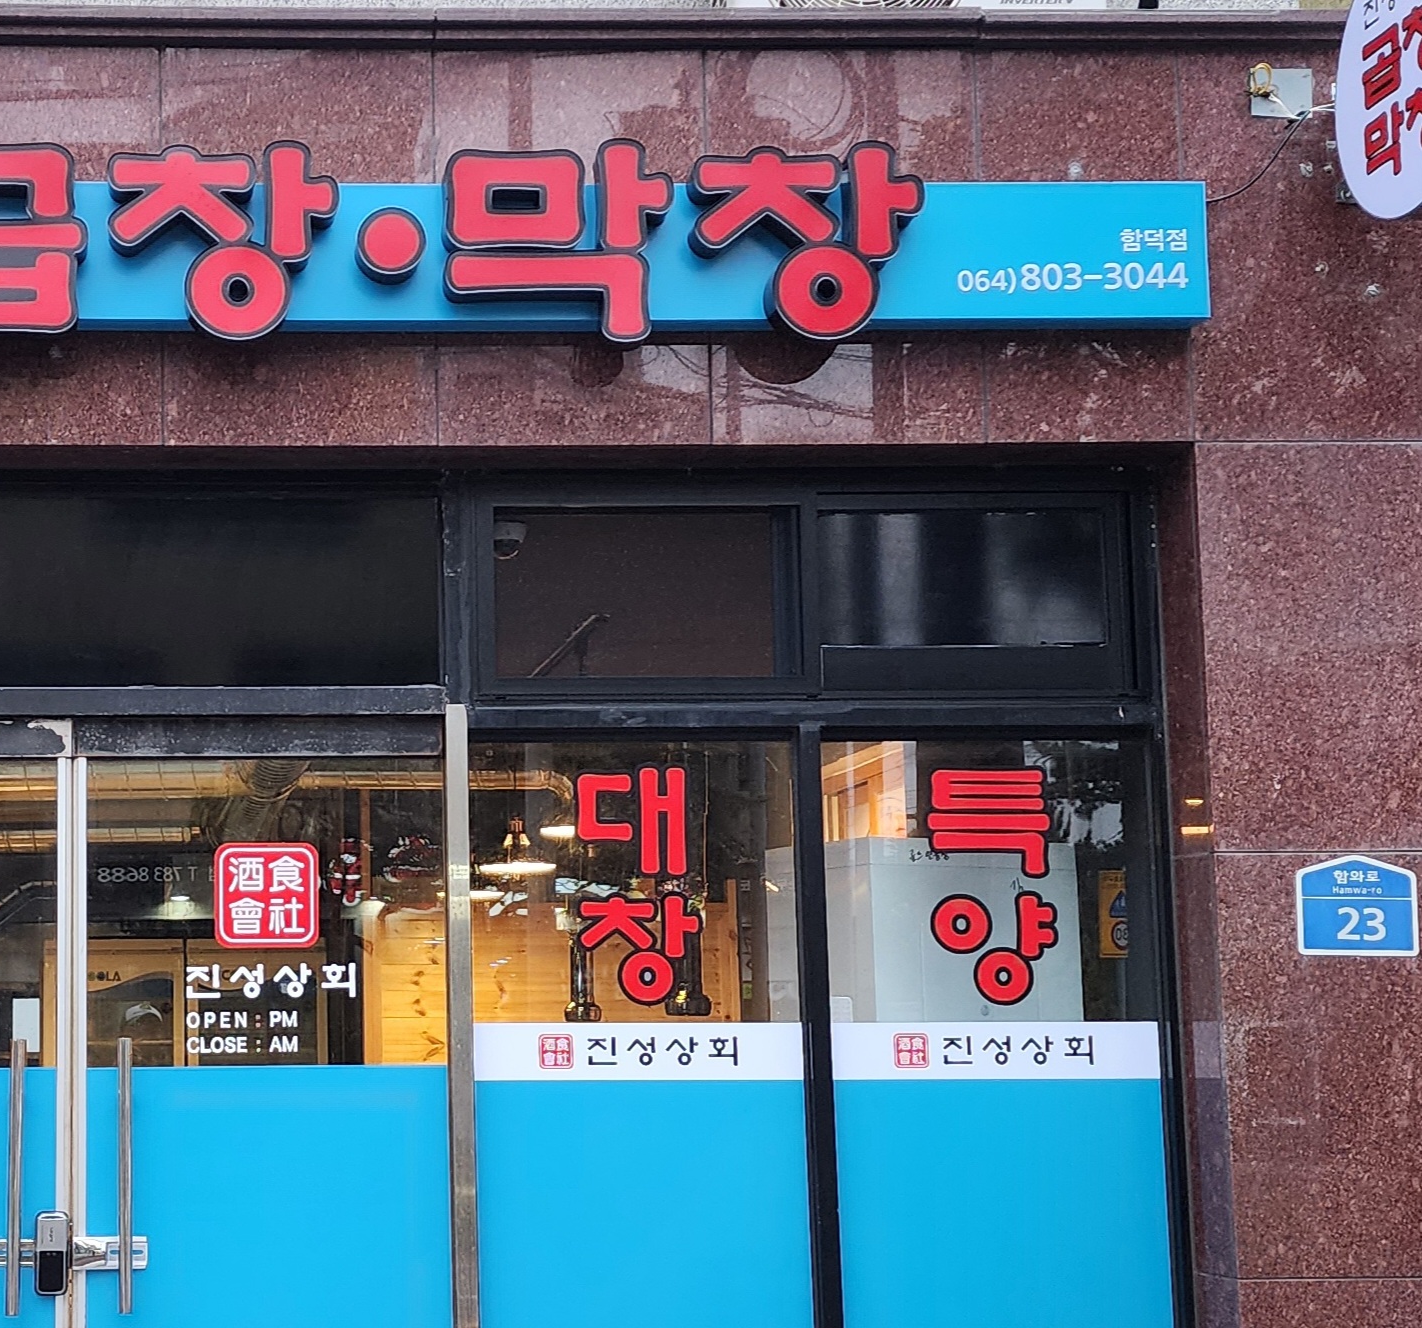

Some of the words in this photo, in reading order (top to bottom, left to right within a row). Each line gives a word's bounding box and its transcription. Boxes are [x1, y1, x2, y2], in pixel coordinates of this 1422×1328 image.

[1119, 228, 1188, 252] 함덕점
[228, 856, 306, 894] 酒食
[577, 766, 703, 1006] 대창
[927, 766, 1059, 1006] 특양
[1332, 870, 1381, 884] 함와로
[1332, 886, 1382, 895] Hamwa-ro
[228, 897, 306, 935] 會社
[1336, 906, 1387, 941] 23
[185, 963, 358, 999] 진성상회
[186, 1011, 248, 1029] OPEN
[269, 1011, 298, 1028] PM
[186, 1036, 248, 1054] CLOSE
[269, 1036, 298, 1053] AM
[587, 1036, 739, 1066] 진성상회
[943, 1035, 1095, 1065] 진성상회
